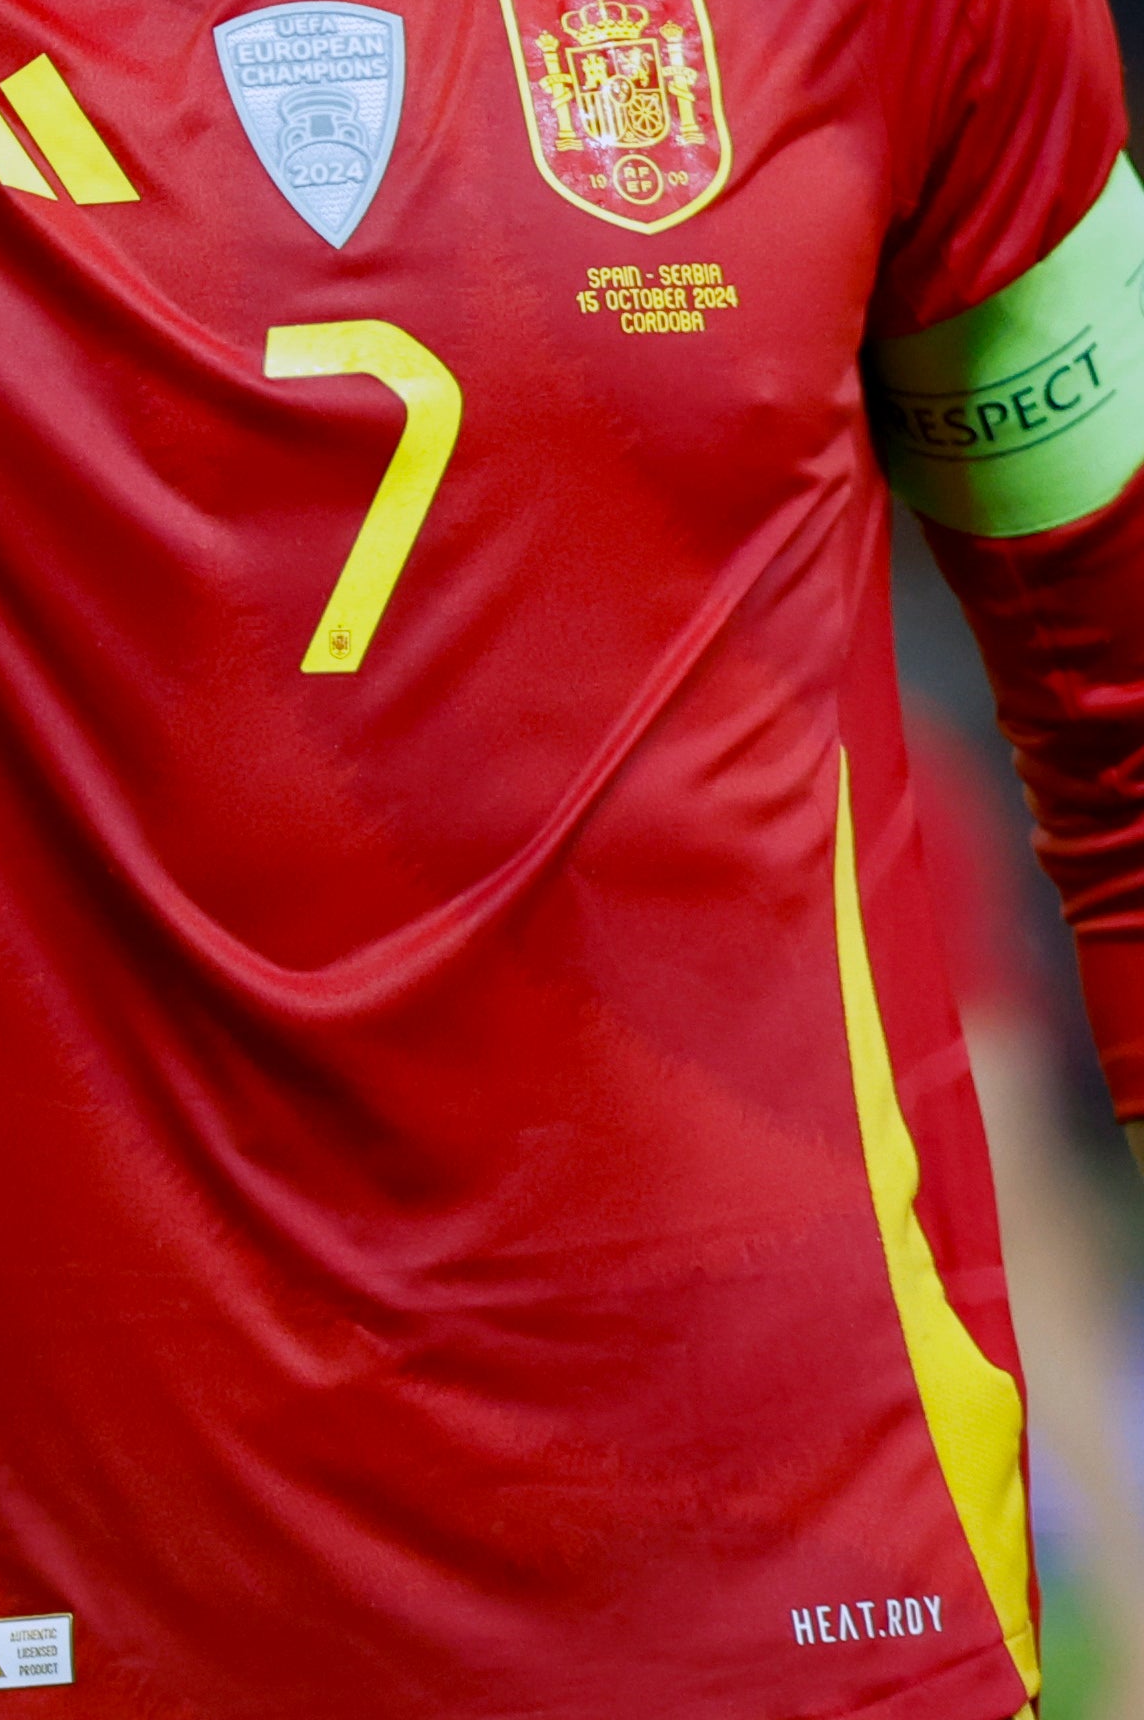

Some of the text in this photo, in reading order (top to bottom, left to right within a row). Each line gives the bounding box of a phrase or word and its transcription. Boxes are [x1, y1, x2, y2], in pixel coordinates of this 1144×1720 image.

[278, 17, 338, 37] UEFA
[237, 35, 384, 65] EUROPEAN
[241, 59, 388, 87] CHAMPIONS
[290, 161, 365, 188] 2024
[589, 173, 608, 189] 19
[623, 166, 650, 179] RF
[587, 265, 643, 289] SPAIN
[658, 263, 723, 286] SERBIA
[576, 285, 739, 314] 15 OCTOBER 2024
[620, 310, 706, 334] CORDOBA
[264, 318, 464, 674] 7
[791, 1595, 943, 1646] HEAT.RDY
[9, 1628, 58, 1643] AUTHENTIC
[17, 1645, 58, 1659] LICENSED
[19, 1662, 59, 1677] PRODUCT
